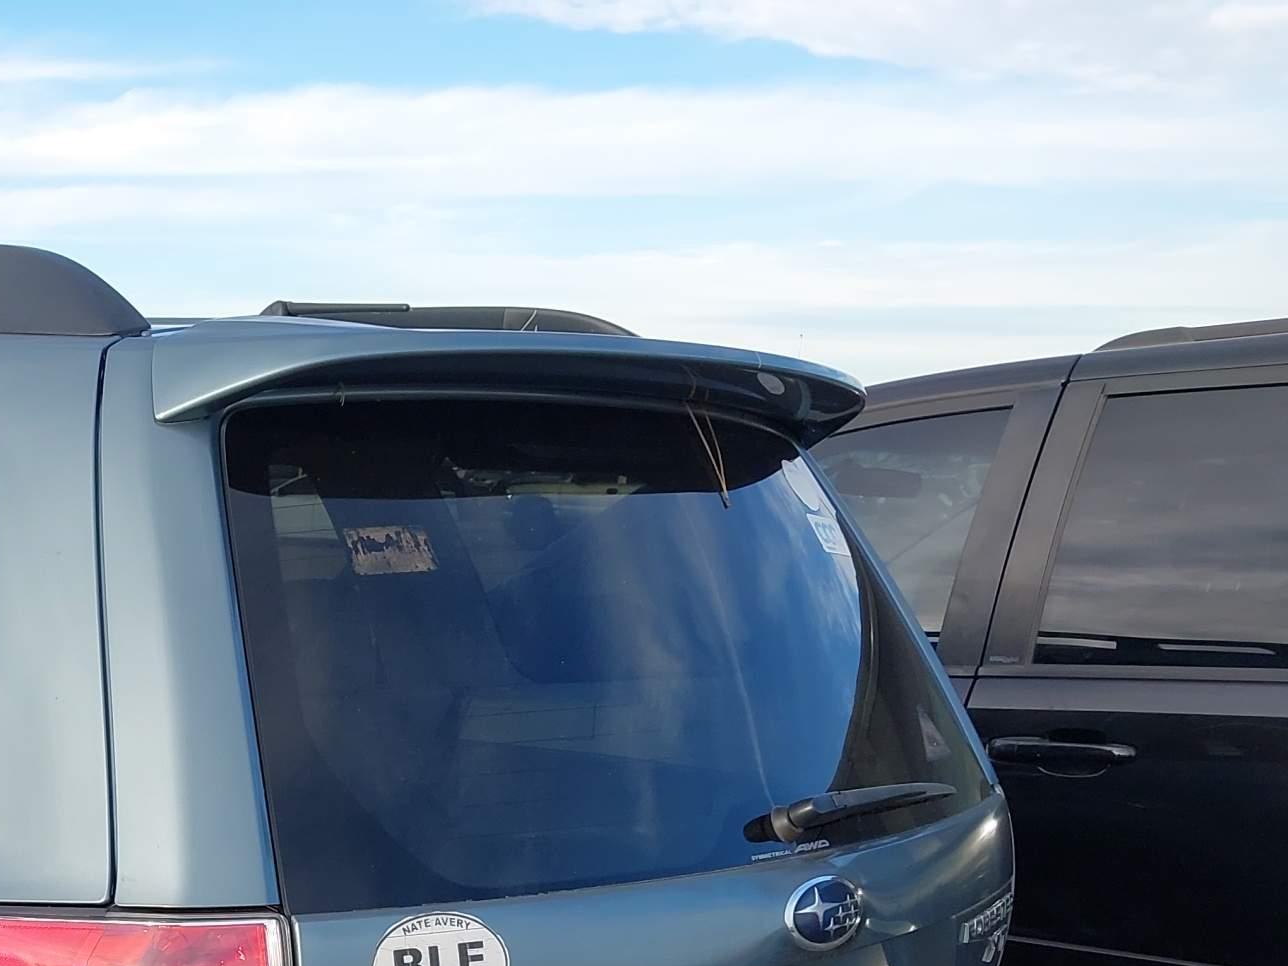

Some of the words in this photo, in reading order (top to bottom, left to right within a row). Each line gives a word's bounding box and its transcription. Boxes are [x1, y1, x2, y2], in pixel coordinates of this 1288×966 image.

[794, 839, 831, 854] AWD
[402, 918, 432, 936] NATE
[434, 917, 471, 930] AVERY
